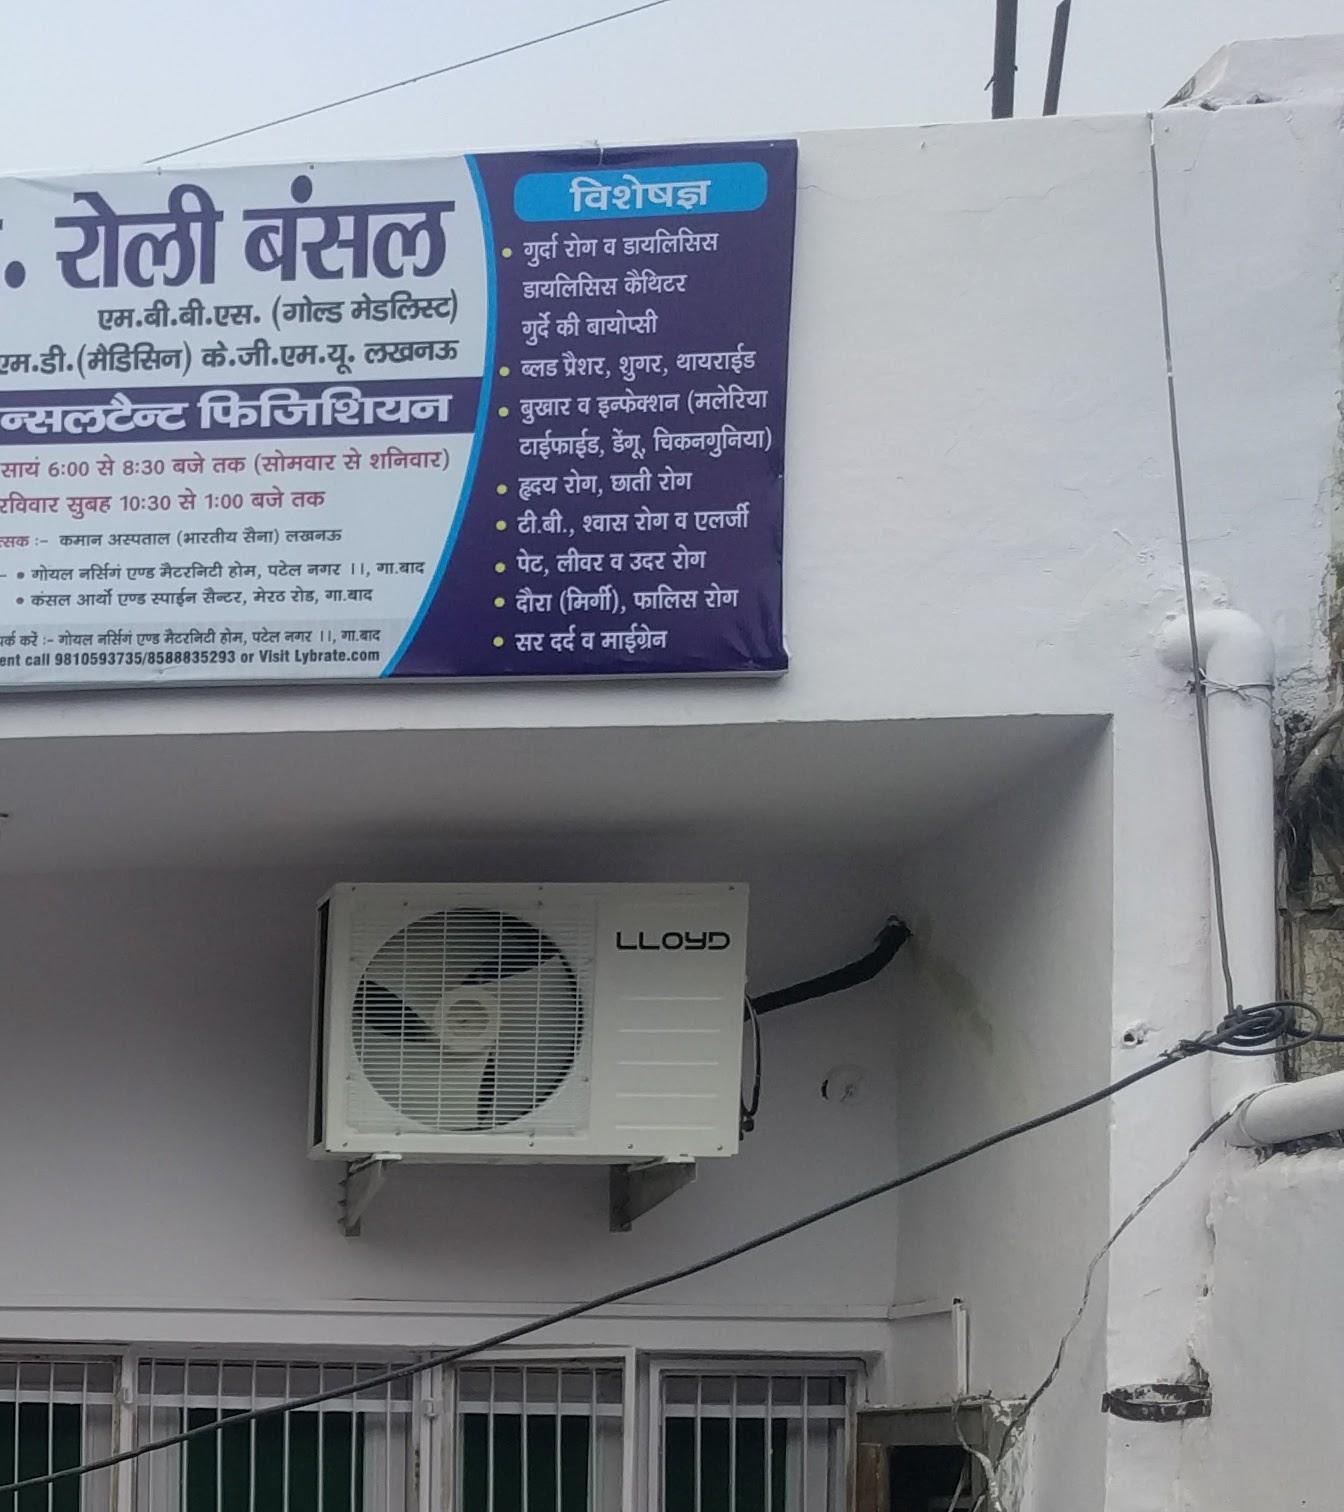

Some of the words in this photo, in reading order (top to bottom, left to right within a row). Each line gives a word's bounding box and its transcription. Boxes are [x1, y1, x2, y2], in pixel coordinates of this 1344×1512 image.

[569, 174, 711, 212] विशेषज्ञ
[55, 184, 224, 288] रोली
[243, 175, 455, 281] बंसल
[523, 233, 558, 267] गुर्दा
[564, 233, 598, 257] रोग
[272, 295, 345, 331] (गोल्ड
[522, 312, 550, 346] गुर्दे
[556, 312, 580, 336] की
[586, 308, 658, 335] बायोप्सी
[364, 340, 460, 364] लखनऊ
[619, 355, 668, 381] शुगर,
[676, 343, 756, 373] थायराईड
[197, 387, 453, 428] फिजिशियन
[0, 457, 40, 478] सायं
[96, 454, 115, 476] से
[172, 452, 205, 474] बजे
[254, 450, 336, 475] (सोमवार
[342, 447, 362, 470] से
[370, 446, 449, 471] शनिवार)
[563, 469, 602, 497] रोग,
[610, 467, 652, 491] छाती
[658, 466, 692, 490] रोग
[66, 496, 112, 519] सुबह
[178, 488, 197, 510] से
[250, 486, 284, 508] बजे
[516, 548, 549, 576] पेट,
[556, 548, 604, 572] लीवर
[672, 544, 706, 569] रोग
[550, 624, 576, 651] दर्द
[616, 931, 730, 950] LLOYD
